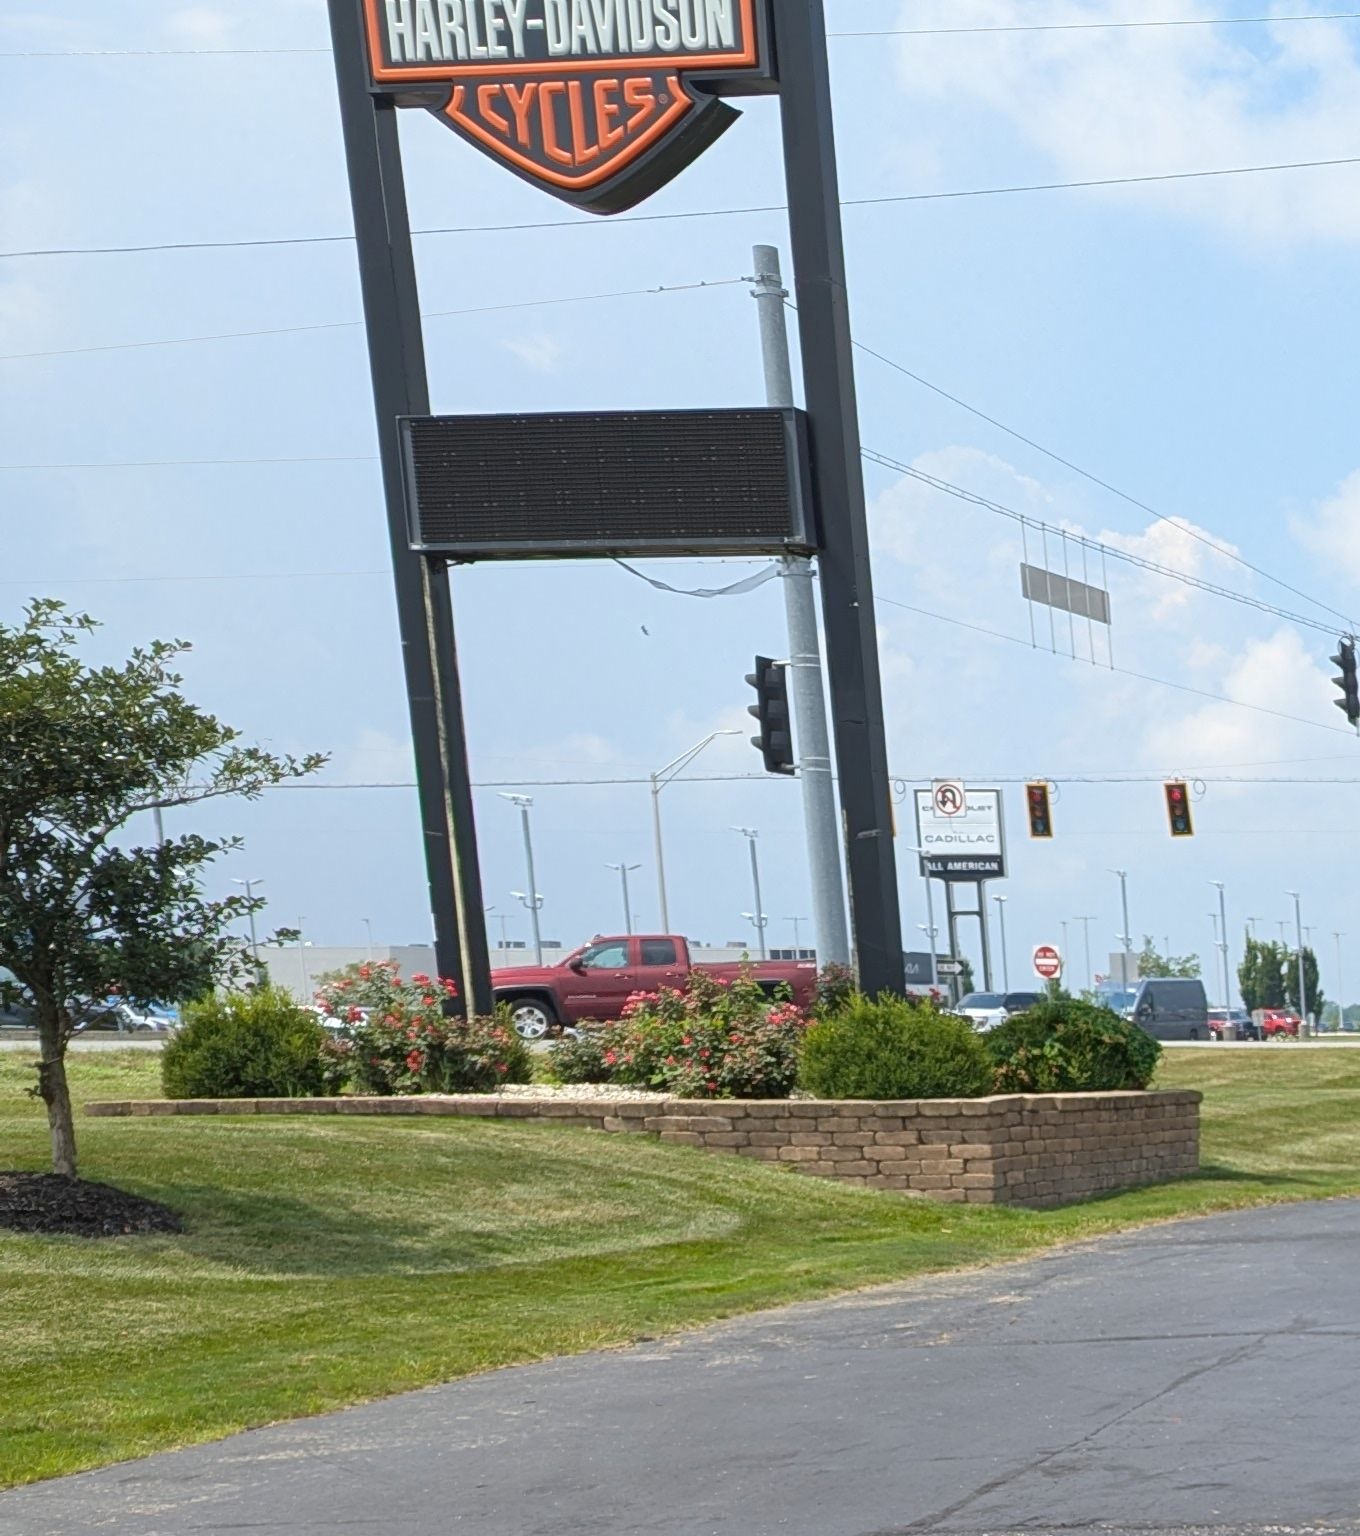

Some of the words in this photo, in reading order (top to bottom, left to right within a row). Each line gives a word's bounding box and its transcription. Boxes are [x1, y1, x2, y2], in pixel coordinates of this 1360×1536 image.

[384, 0, 735, 62] HARLEY-DAVIDSON
[477, 77, 656, 168] CYCLES
[924, 834, 995, 843] CADILLAC
[927, 861, 944, 871] ALL
[946, 861, 999, 871] AMERICAN
